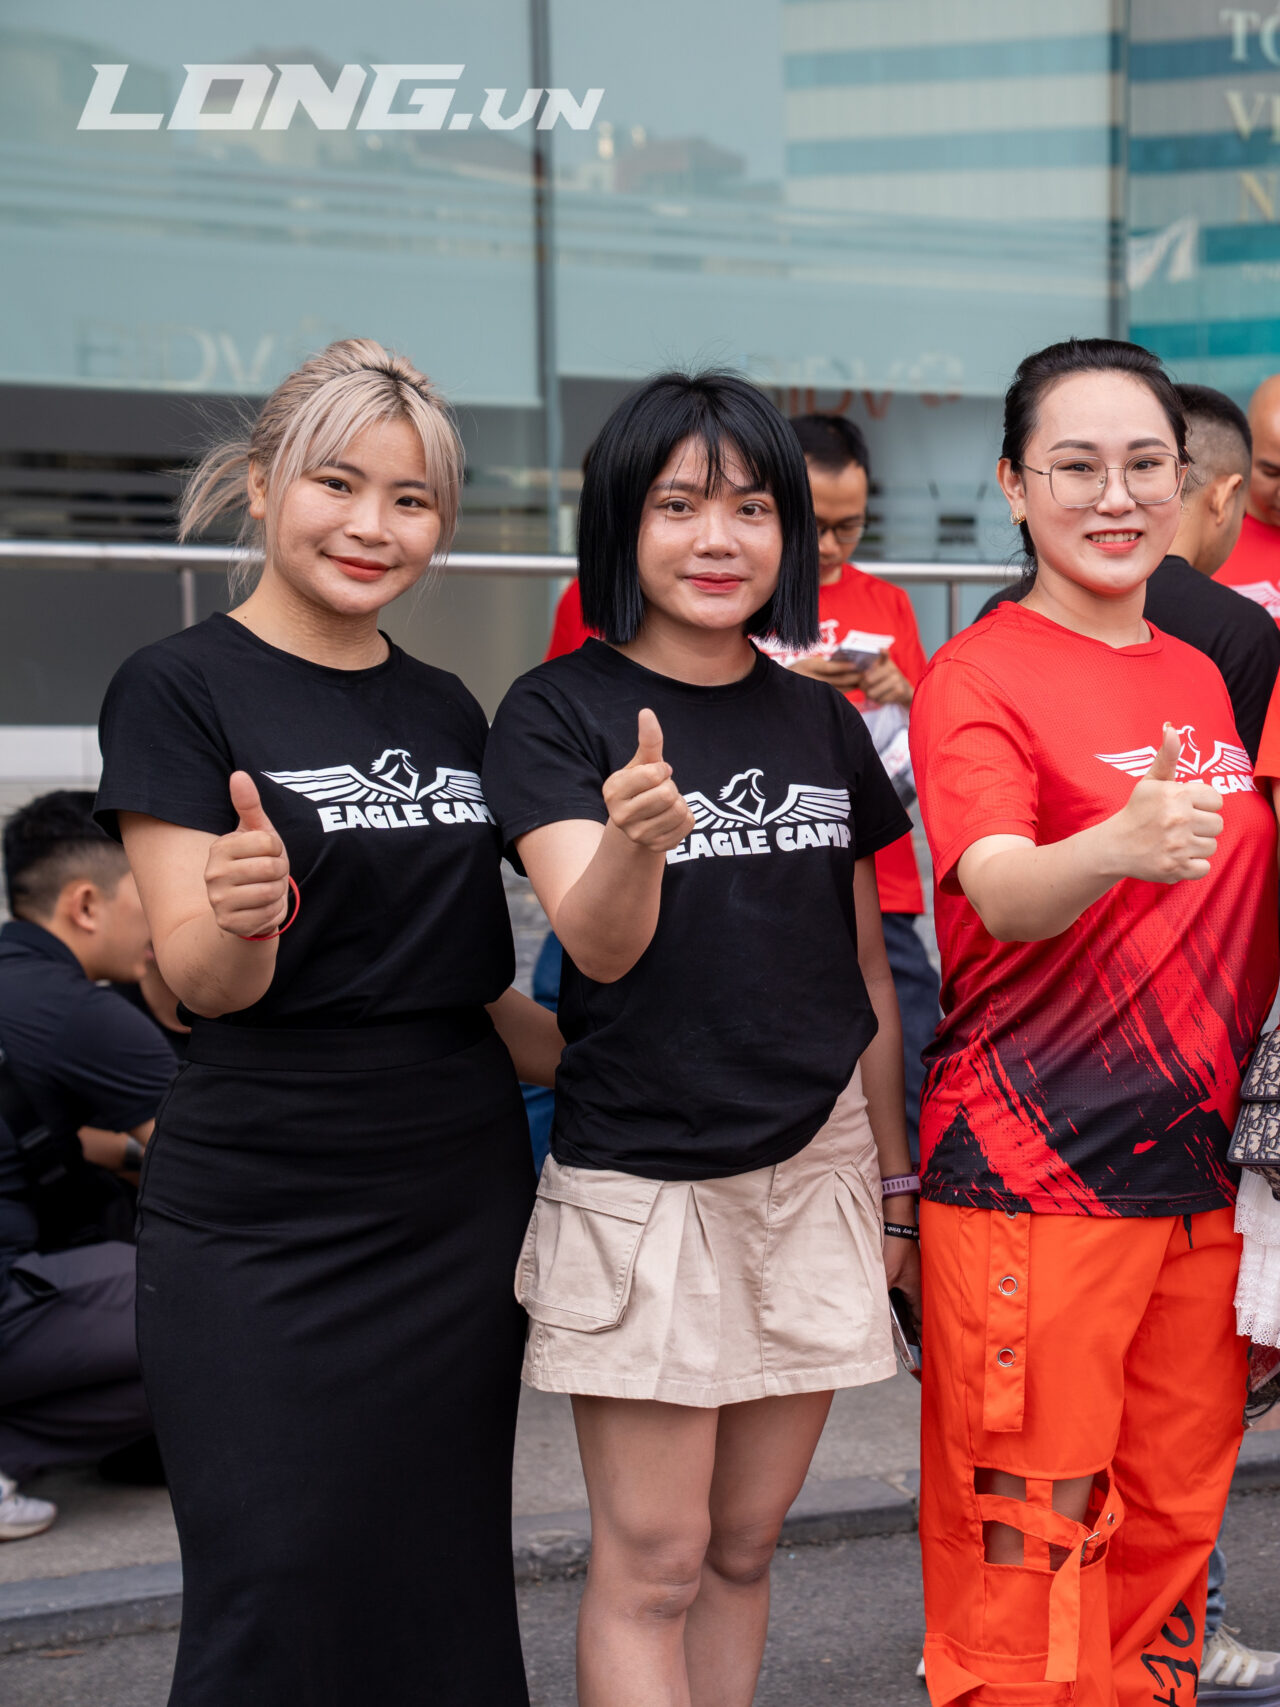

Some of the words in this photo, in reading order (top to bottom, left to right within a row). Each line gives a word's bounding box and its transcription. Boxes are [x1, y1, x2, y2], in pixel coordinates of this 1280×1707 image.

[317, 803, 430, 833] EAGLE
[432, 802, 496, 826] CAM
[666, 829, 772, 865] EAGLE
